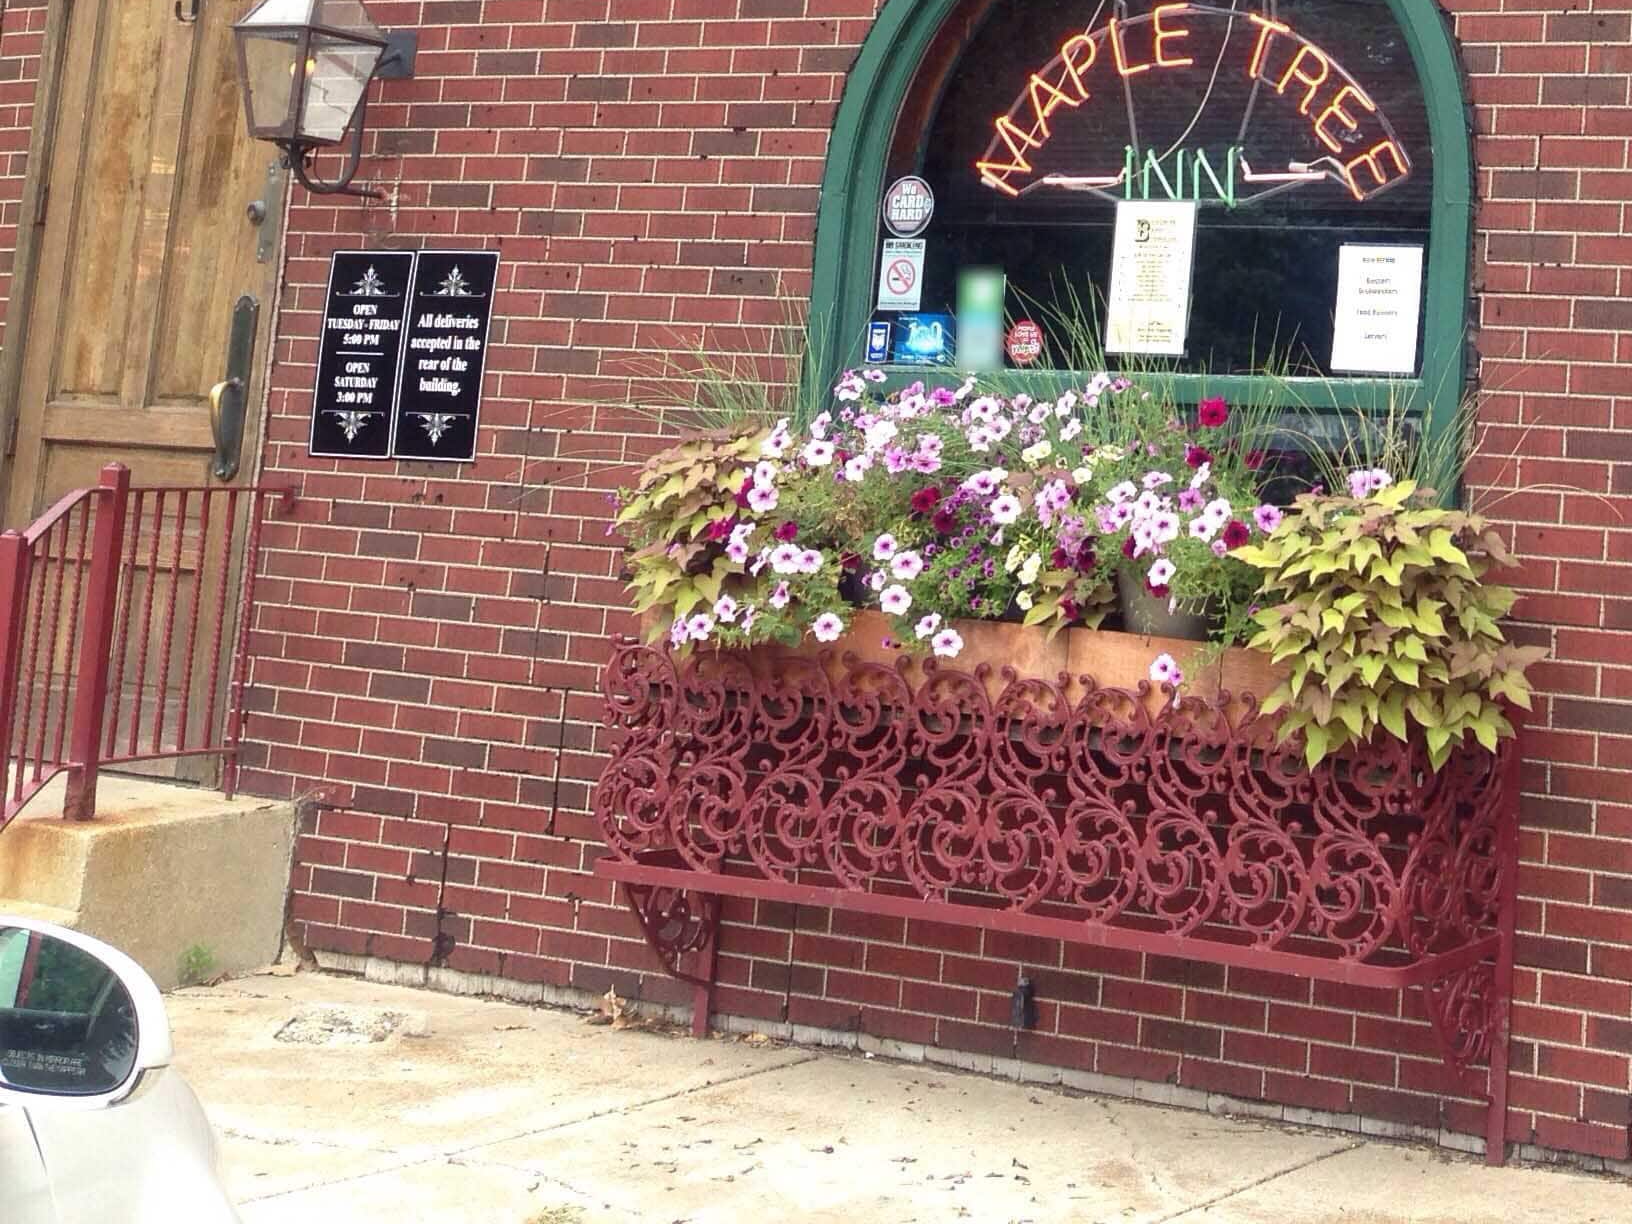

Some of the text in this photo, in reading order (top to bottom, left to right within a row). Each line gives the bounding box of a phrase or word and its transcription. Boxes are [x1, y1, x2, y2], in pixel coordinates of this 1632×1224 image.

[976, 2, 1408, 201] MAPLE TREE
[1123, 145, 1240, 207] INN
[892, 195, 924, 209] CARD
[891, 208, 923, 221] HARD
[353, 304, 378, 316] OPEN
[327, 318, 365, 331] TUESDAY
[368, 319, 401, 331] FRIDAY
[417, 313, 480, 329] All deliveries
[343, 333, 380, 346] 5:00 PM
[410, 336, 481, 353] accepted in the
[345, 361, 371, 374] OPEN
[418, 356, 468, 372] rear of the
[334, 375, 379, 389] SATURDAY
[335, 391, 374, 404] 3:00 PM
